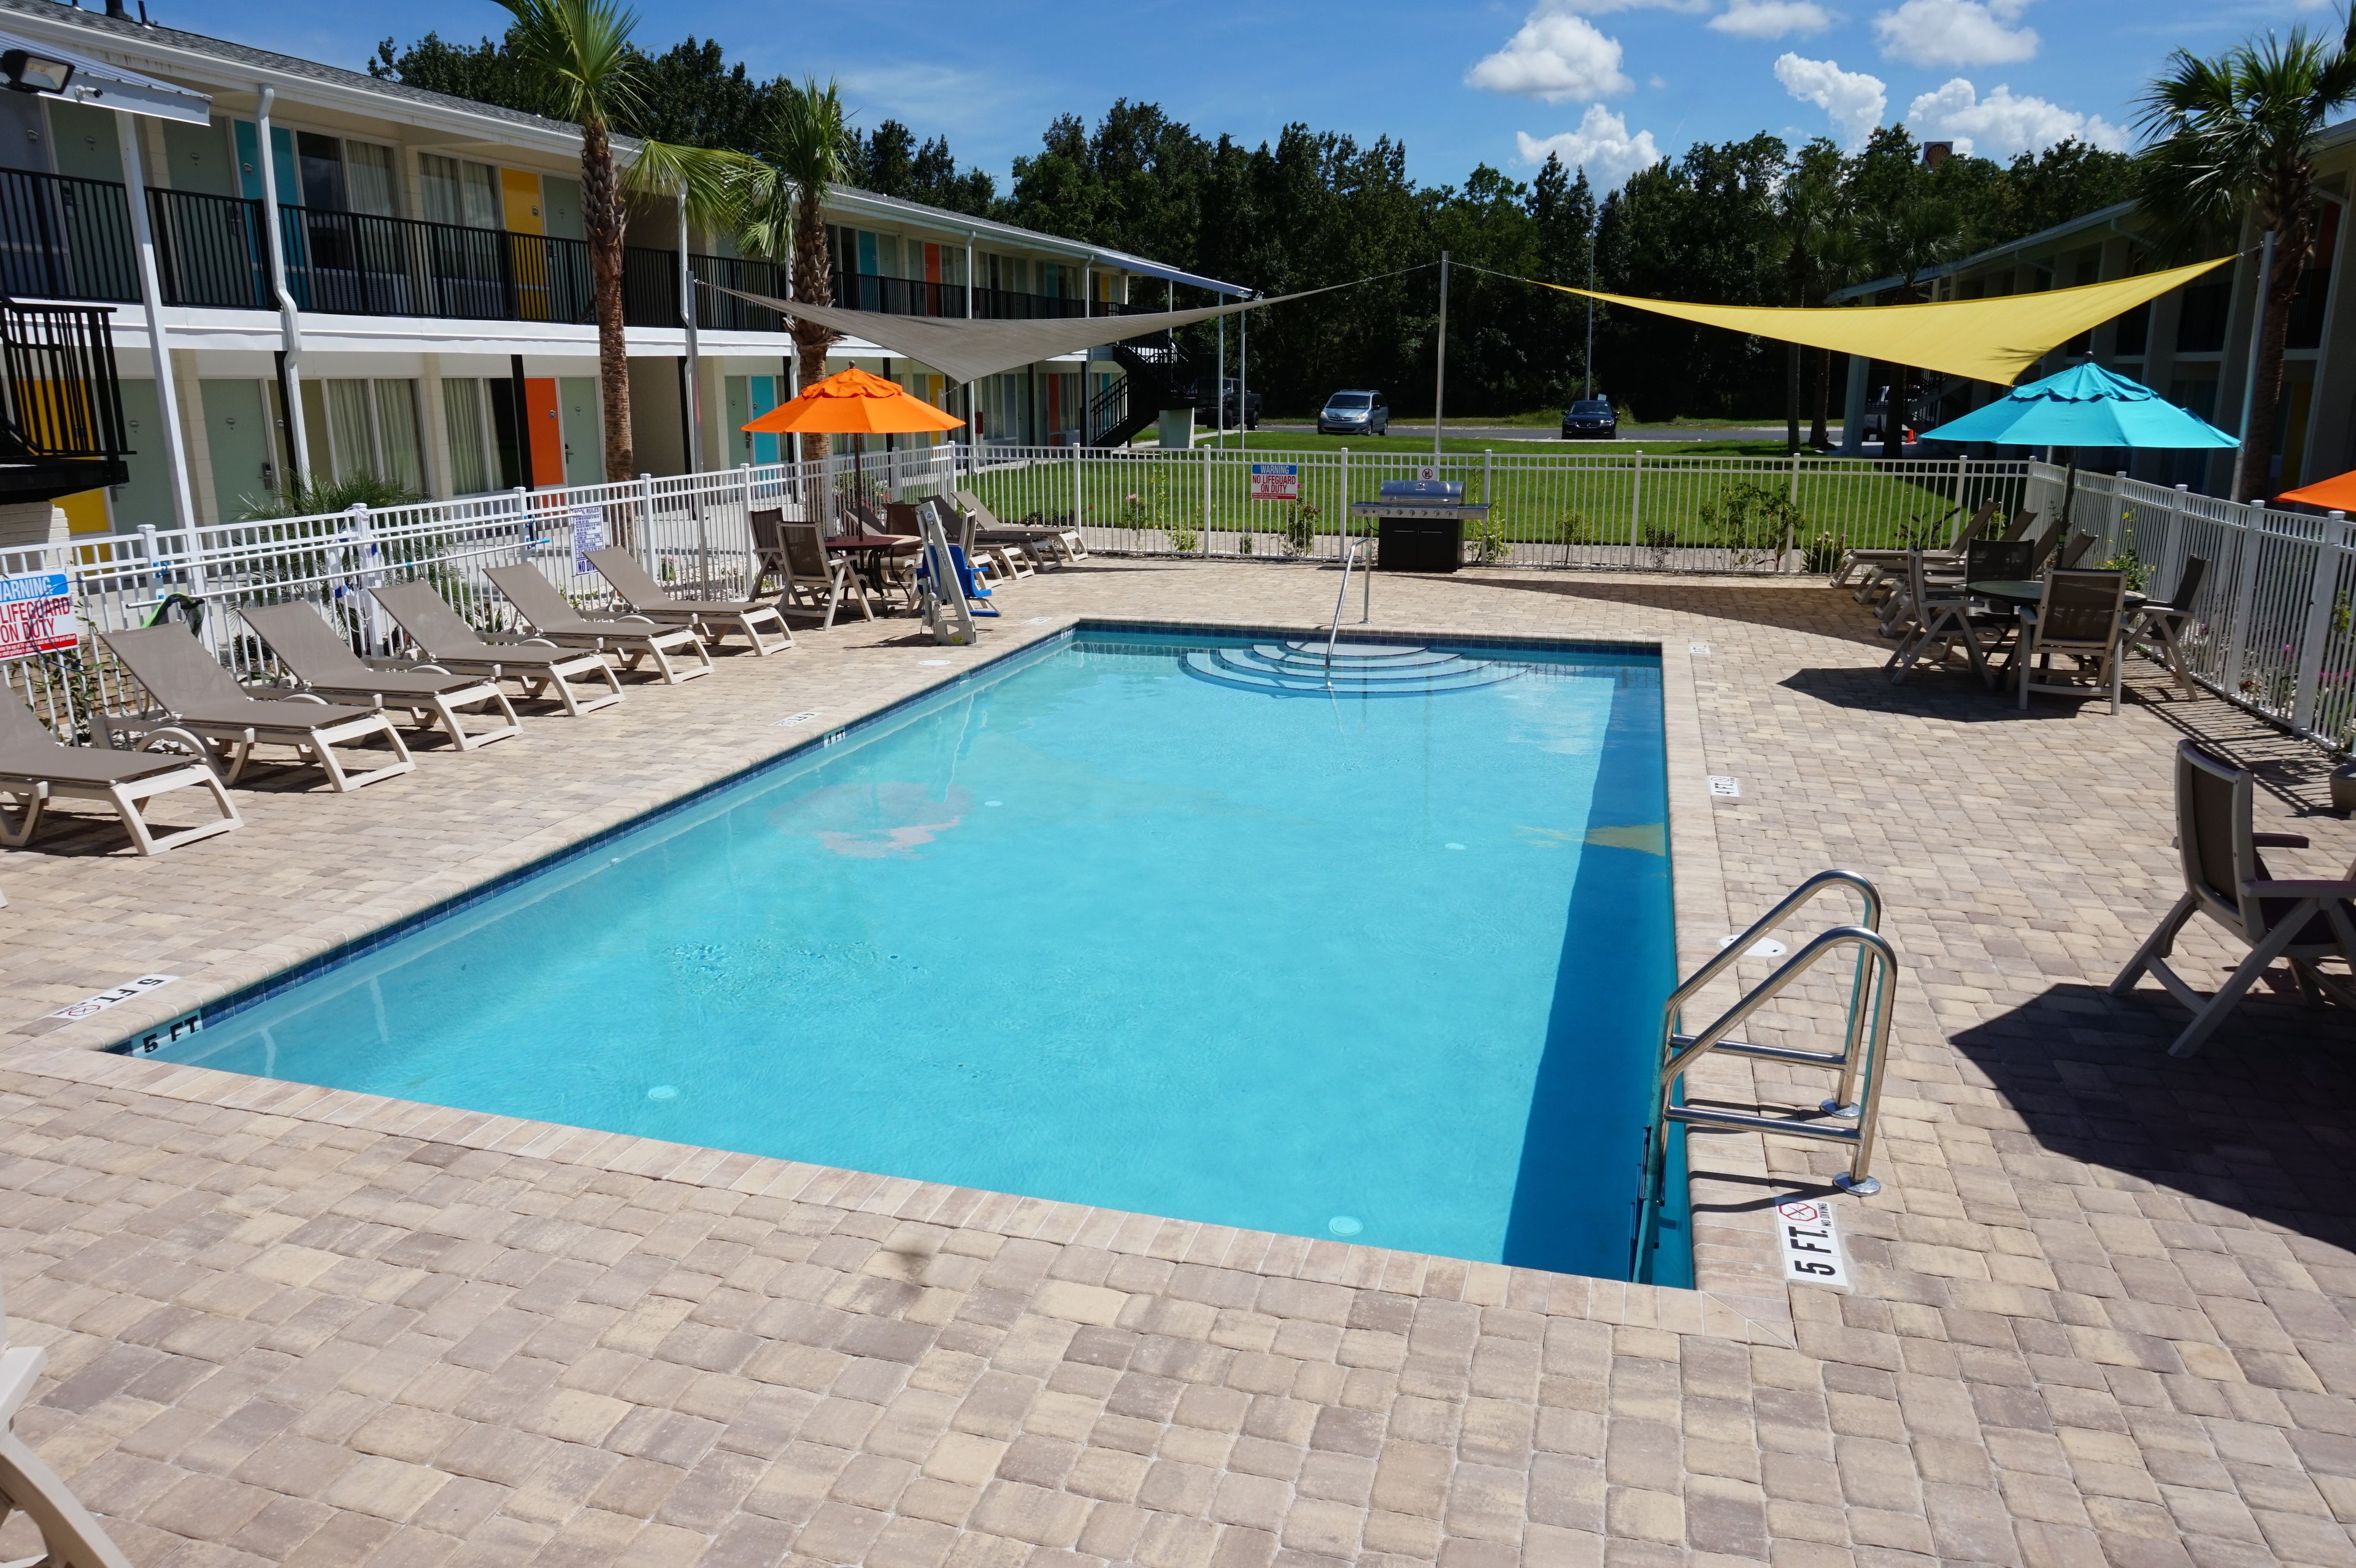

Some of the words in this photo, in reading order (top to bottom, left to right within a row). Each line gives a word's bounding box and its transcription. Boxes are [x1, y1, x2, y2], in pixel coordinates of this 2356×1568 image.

[1260, 465, 1289, 474] WARNING
[1252, 475, 1261, 484] NO
[1263, 475, 1296, 485] LIFEGUARD
[1261, 484, 1269, 493] ON
[1271, 485, 1287, 493] DUTY
[578, 560, 585, 573] NO
[0, 576, 53, 601] ARNING
[0, 597, 71, 624] LIFEGUARD
[0, 623, 20, 644] ON
[22, 618, 55, 640] DUTY
[142, 1033, 159, 1053] 5
[1817, 1202, 1830, 1219] DIVING
[1822, 1218, 1831, 1227] NO
[1788, 1226, 1832, 1254] FT.
[1794, 1260, 1836, 1276] 5
